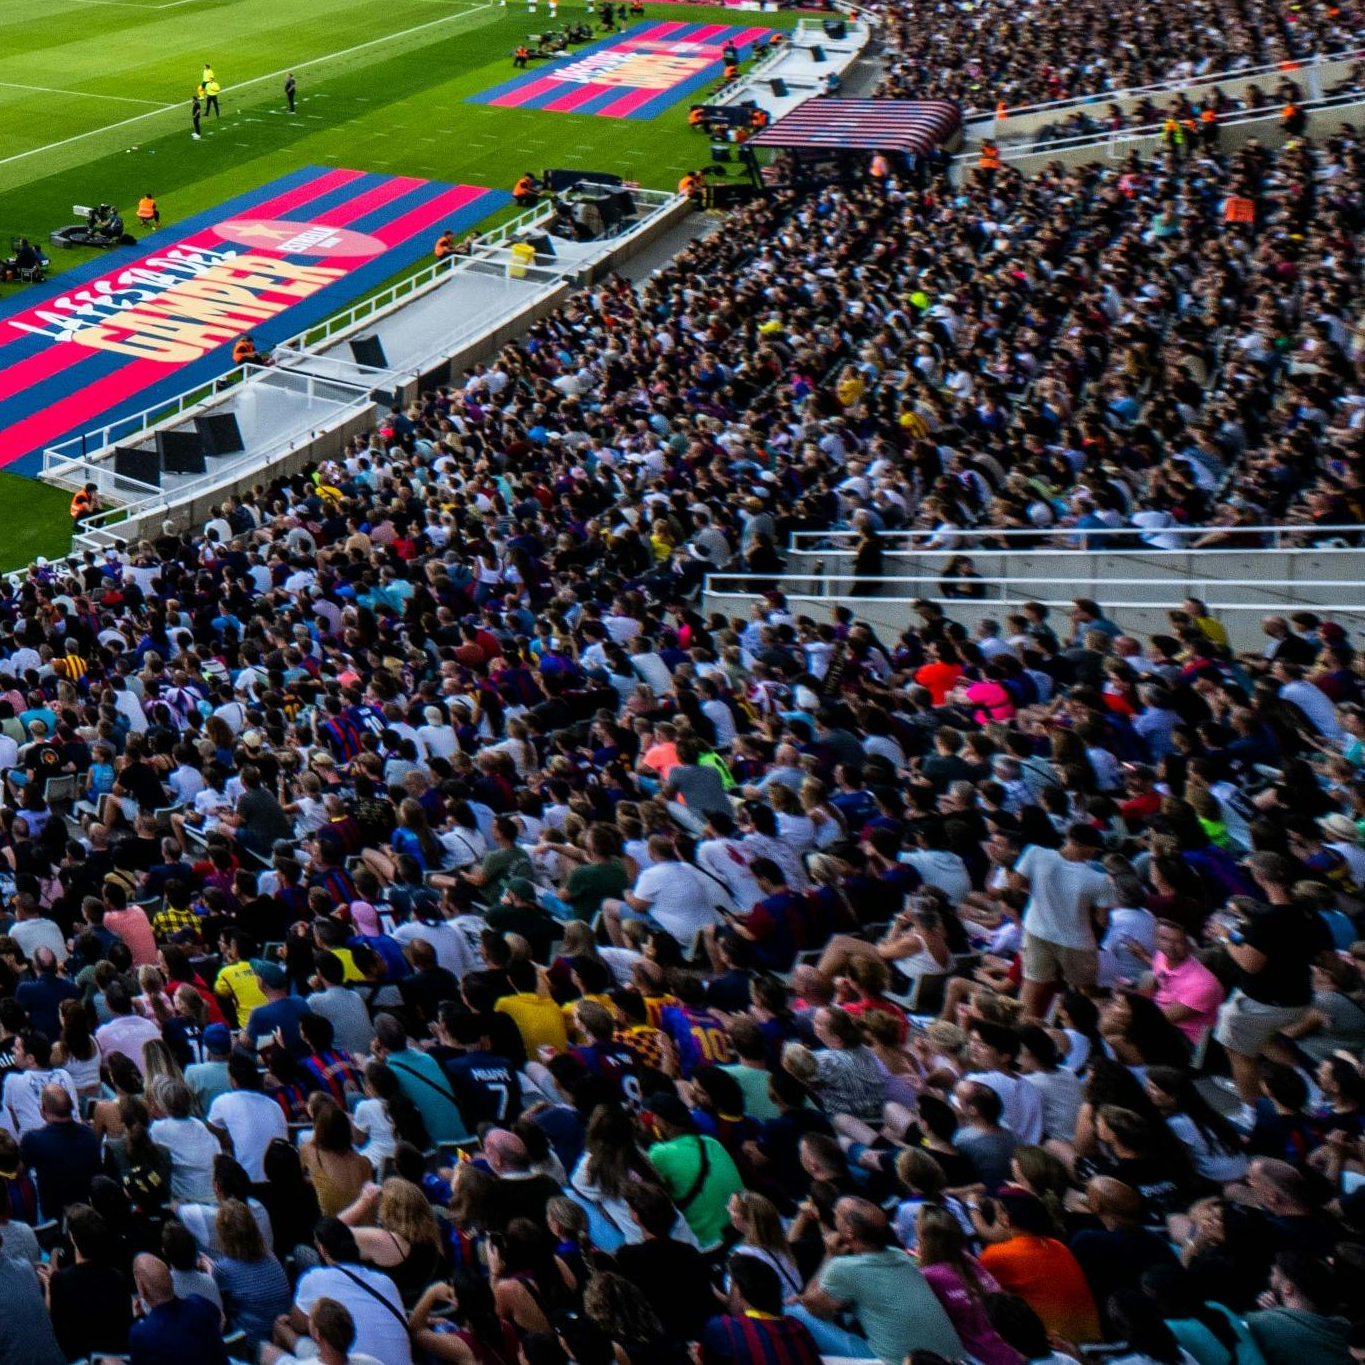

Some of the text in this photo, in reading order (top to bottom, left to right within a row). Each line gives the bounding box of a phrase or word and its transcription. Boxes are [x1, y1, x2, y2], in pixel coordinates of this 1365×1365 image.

[8, 244, 241, 342] LA FESTA DEL
[72, 254, 348, 363] GAMPER
[691, 1025, 729, 1064] 10
[487, 1083, 509, 1121] 7
